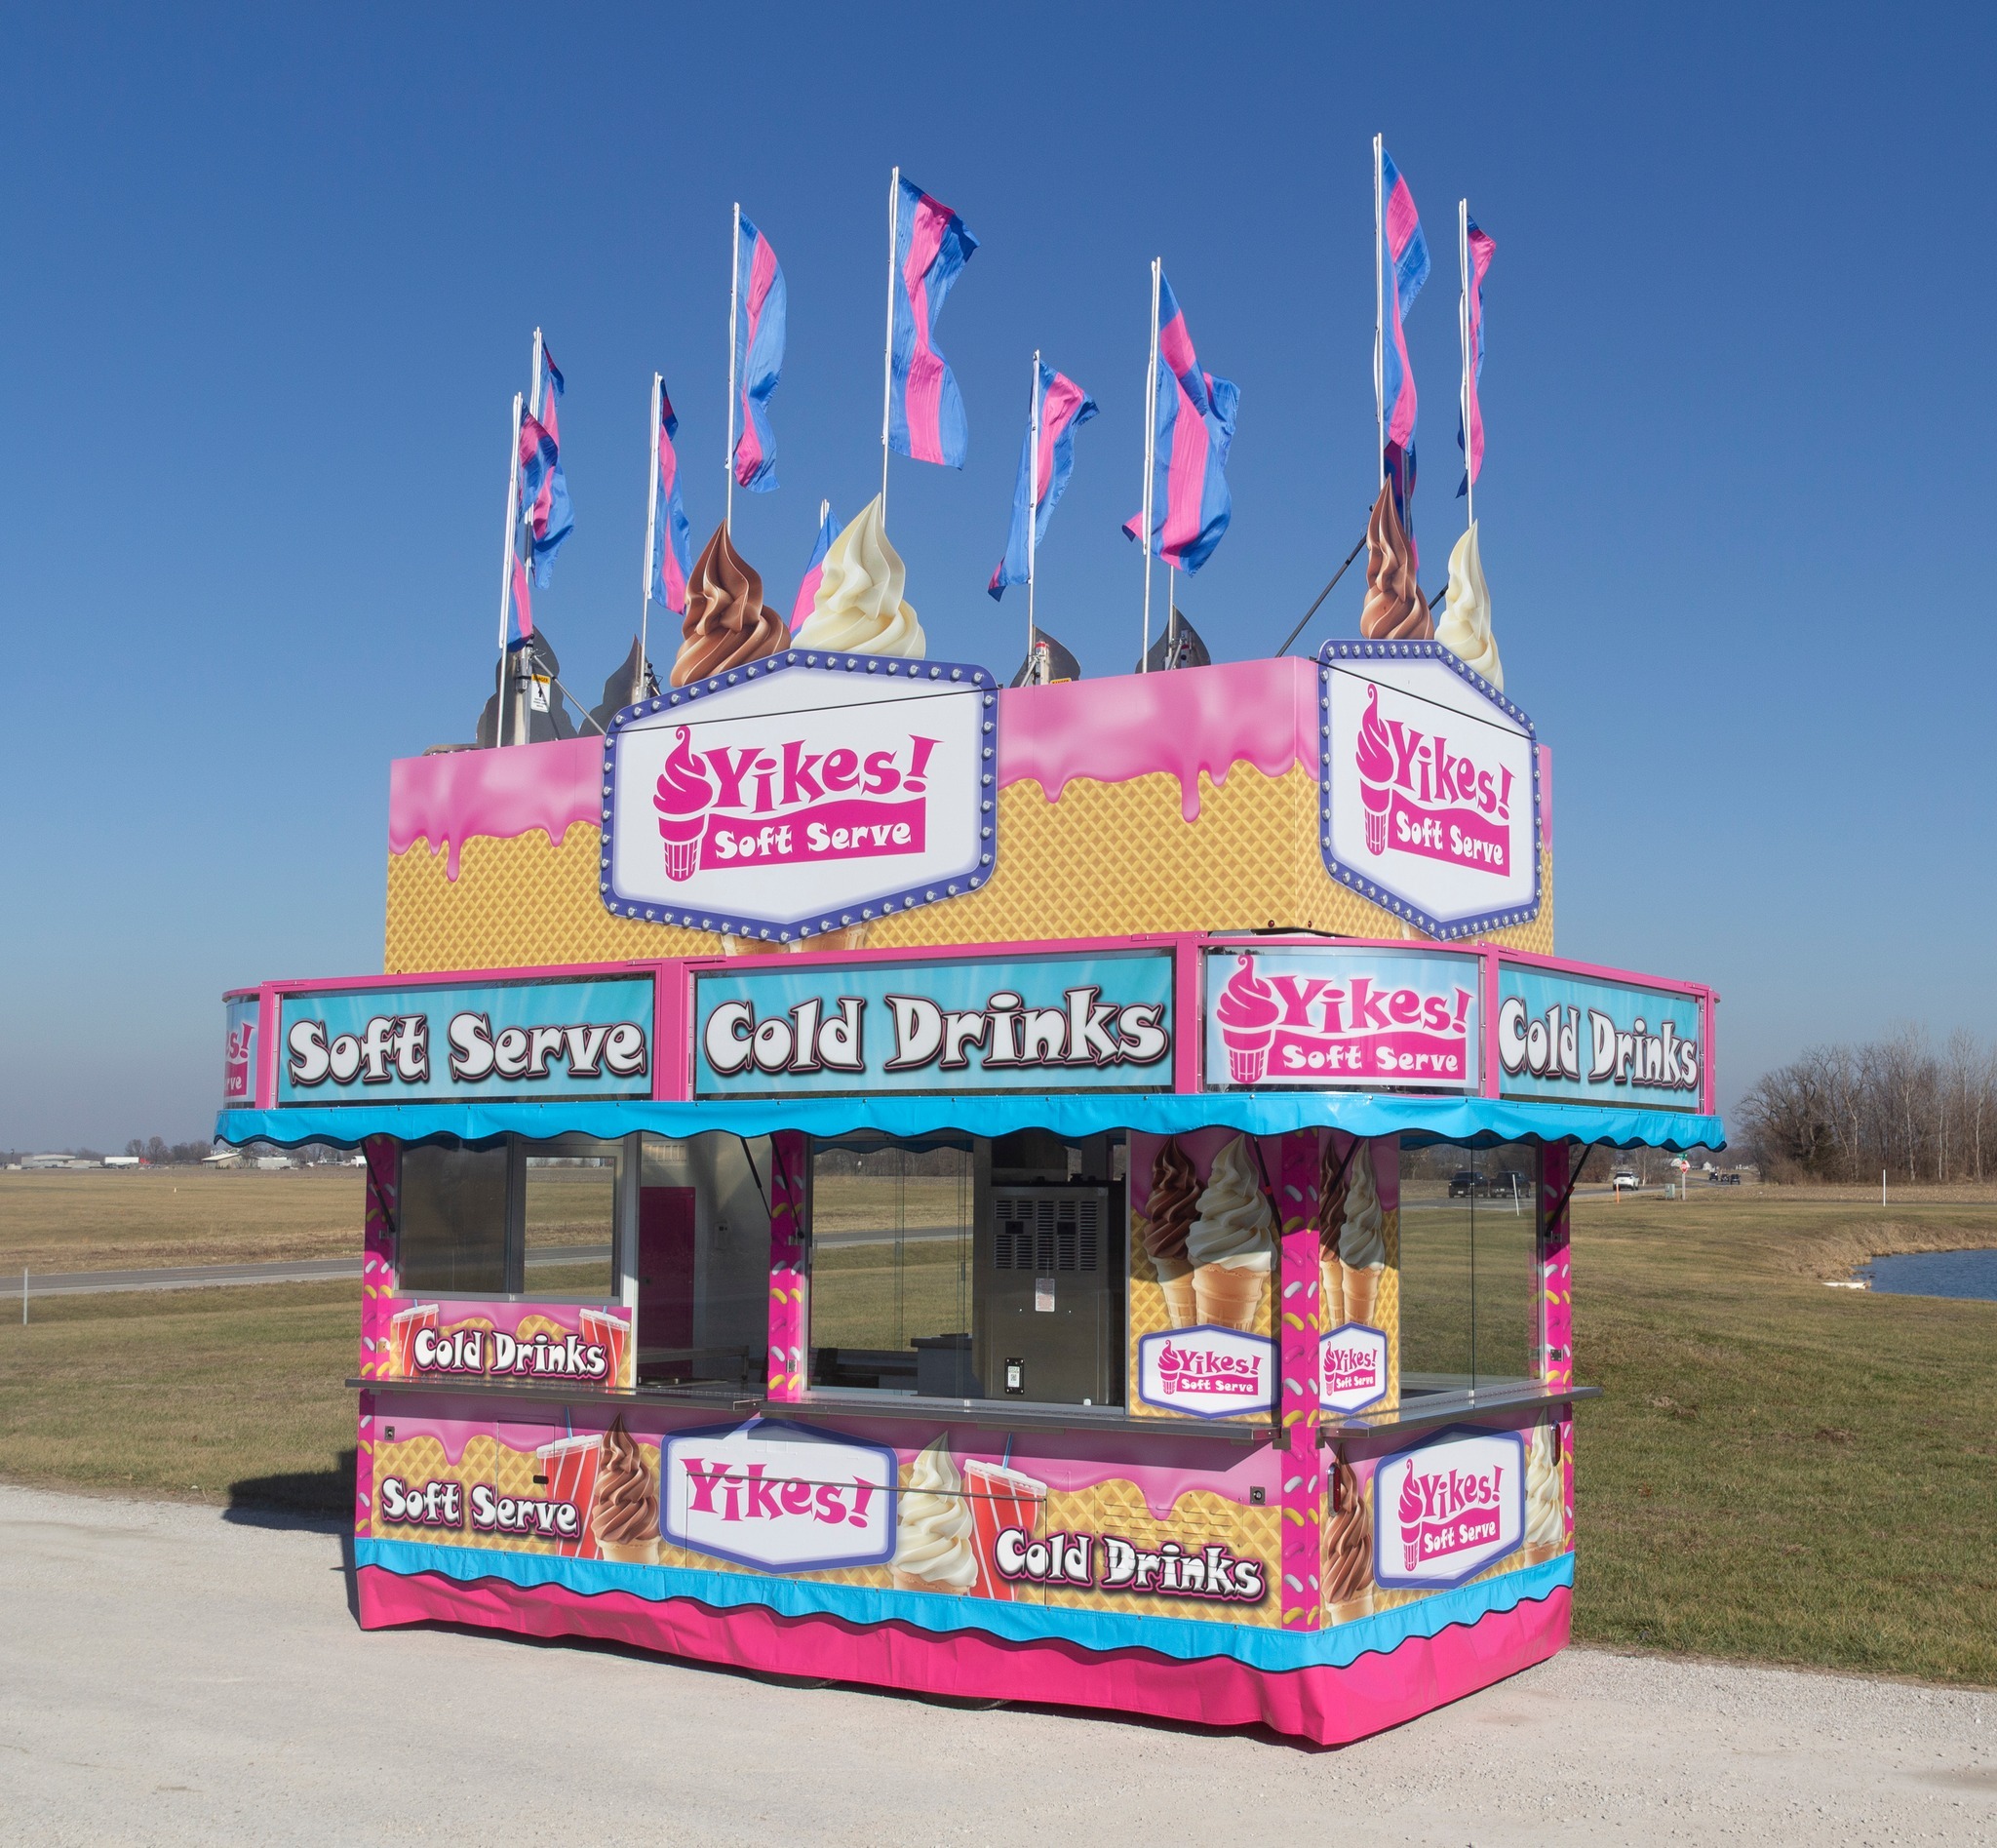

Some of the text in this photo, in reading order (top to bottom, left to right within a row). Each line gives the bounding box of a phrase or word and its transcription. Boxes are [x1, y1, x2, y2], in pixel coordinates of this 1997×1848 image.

[701, 734, 944, 814] Yikes!
[1385, 719, 1516, 820] Yikes!
[715, 822, 912, 860] Soft Serve
[1396, 809, 1504, 866] Soft Serve
[704, 985, 1171, 1074] Cold Drinks
[1266, 975, 1474, 1035] Yikes!
[289, 1009, 648, 1085] Soft Serve
[1282, 1043, 1459, 1072] Soft Serve
[1499, 996, 1698, 1089] Cold Drinks
[413, 1327, 608, 1380] Cold Drinks
[1176, 1349, 1264, 1375] Yikes!
[1333, 1348, 1378, 1373] Yikes!
[1336, 1375, 1374, 1389] Soft Serve
[1181, 1378, 1254, 1393] Soft Serve
[380, 1474, 581, 1538] Soft Serve
[680, 1457, 877, 1528] Yikes!
[1417, 1464, 1506, 1520] Yikes!
[994, 1525, 1266, 1602] Cold Drinks
[1424, 1520, 1496, 1553] Soft Serve
